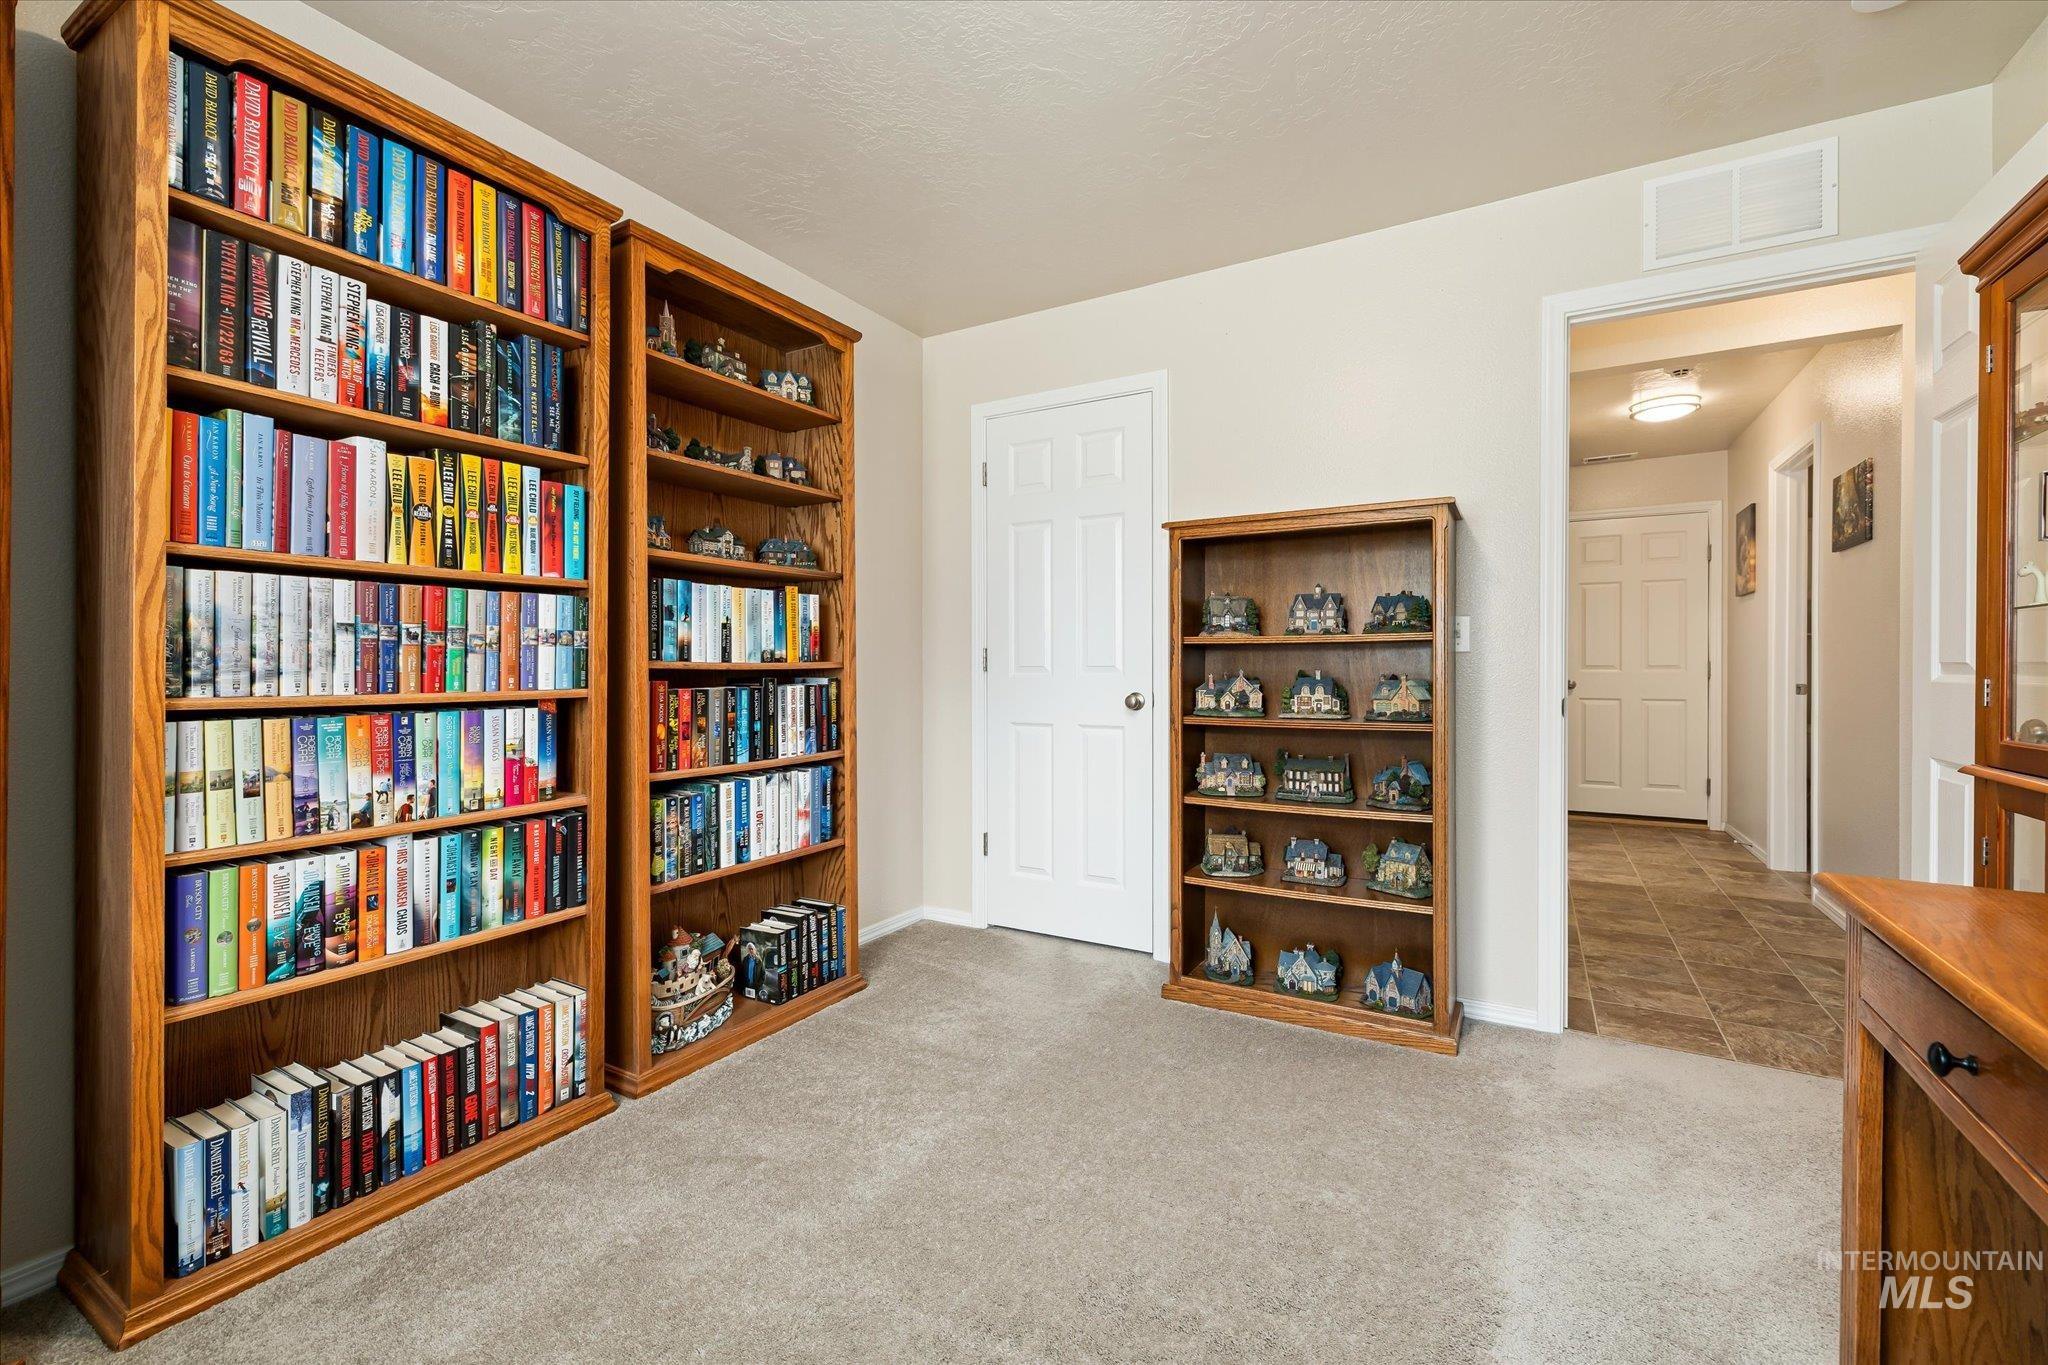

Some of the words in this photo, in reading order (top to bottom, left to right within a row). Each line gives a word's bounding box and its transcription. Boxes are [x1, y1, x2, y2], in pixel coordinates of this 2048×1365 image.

[205, 72, 217, 97] DAVID
[244, 80, 260, 115] DAVID
[205, 99, 217, 141] BALDACCI
[284, 99, 298, 130] DAVID
[244, 119, 258, 176] BALDACCI
[284, 131, 298, 182] BALDACCI
[359, 133, 369, 160] DAVID
[205, 151, 217, 176] ESCAPE
[392, 147, 406, 178] DAVID
[281, 182, 293, 206] MAN
[359, 162, 369, 205] BALDACCI
[456, 190, 464, 209] DAVID
[482, 199, 490, 219] DAVID
[366, 215, 372, 226] NO
[456, 211, 464, 242] BALDACCI
[507, 209, 515, 228] DAVID
[391, 232, 401, 248] FIX
[482, 220, 490, 254] BALDACCI
[531, 220, 539, 241] DAVID
[555, 230, 564, 247] DAVID
[507, 230, 515, 259] BALDACCI
[220, 240, 237, 279] STEPHEN
[251, 254, 268, 286] STEPHEN
[531, 245, 540, 281] BALDACCI
[555, 249, 564, 275] BALDACCI
[291, 261, 302, 295] STEPHEN
[507, 261, 515, 288] REDEMPTION
[221, 284, 236, 305] KING
[255, 288, 273, 318] KING
[321, 275, 332, 312] STEPHEN
[346, 282, 361, 323] STEPHEN
[290, 297, 302, 315] KING
[321, 314, 332, 335] KING
[400, 313, 410, 326] LISA
[219, 315, 233, 365] 11/22/63
[250, 317, 273, 363] REVIVAL
[346, 326, 360, 349] KING
[400, 327, 410, 358] GARDNER
[430, 334, 438, 360] GARDNER
[461, 330, 469, 344] LISA
[289, 335, 300, 375] MERCEDES
[314, 349, 325, 383] KEEPERS
[327, 345, 336, 378] FINDERS
[352, 360, 362, 372] END
[461, 348, 469, 380] GARDNER
[341, 358, 351, 379] WATCH
[352, 373, 362, 383] OF
[430, 362, 440, 384] CRASH
[430, 391, 440, 409] BURN
[461, 386, 469, 402] FIND
[369, 448, 377, 466] JAN
[369, 468, 377, 499] KARON
[393, 469, 402, 481] LEE
[419, 474, 427, 484] LEE
[444, 466, 453, 480] LEE
[468, 470, 478, 483] LEE
[508, 477, 517, 490] LEE
[208, 495, 218, 512] Song
[393, 483, 403, 503] CHILD
[419, 485, 427, 503] CHILD
[444, 482, 454, 504] CHILD
[468, 485, 478, 507] CHILD
[508, 491, 518, 512] CHILD
[509, 527, 517, 539] PAST
[509, 540, 517, 555] TENSE
[375, 726, 383, 747] CARR
[491, 715, 499, 737] SUSAN
[297, 735, 307, 762] CARR
[308, 735, 318, 761] ROBYN
[325, 735, 334, 758] CARR
[333, 735, 341, 758] ROBYN
[376, 753, 384, 775] HOPE
[756, 810, 764, 827] LOVE
[397, 848, 407, 865] IRIS
[446, 844, 455, 877] JOHANSEN
[367, 854, 378, 892] JOHANSEN
[512, 859, 520, 878] AWAY
[335, 864, 351, 905] JOHANSEN
[396, 866, 408, 908] JOHANSEN
[273, 874, 290, 920] JOHANSEN
[303, 871, 320, 913] JOHANSEN
[313, 924, 321, 956] HUNTING
[396, 909, 407, 936] CHAOS
[525, 1015, 534, 1030] JAMES
[544, 1007, 552, 1030] JAMES
[506, 1022, 516, 1039] JAMES
[465, 1046, 476, 1063] JAMES
[506, 1039, 516, 1066] PATTERSON
[525, 1030, 535, 1057] PATTERSON
[544, 1031, 552, 1072] PATTERSON
[466, 1063, 477, 1093] PATTERSON
[525, 1063, 534, 1079] NYPD
[361, 1085, 374, 1100] JAMES
[362, 1100, 374, 1130] PATTERSON
[465, 1095, 478, 1124] GONE
[270, 1117, 281, 1147] DANIELLE
[363, 1131, 374, 1149] TICK
[239, 1128, 249, 1161] DANIELLE
[211, 1140, 224, 1175] DANIELLE
[271, 1148, 281, 1166] STEEL
[363, 1151, 373, 1173] TOCK
[239, 1161, 249, 1180] STEEL
[211, 1175, 224, 1198] STEEL
